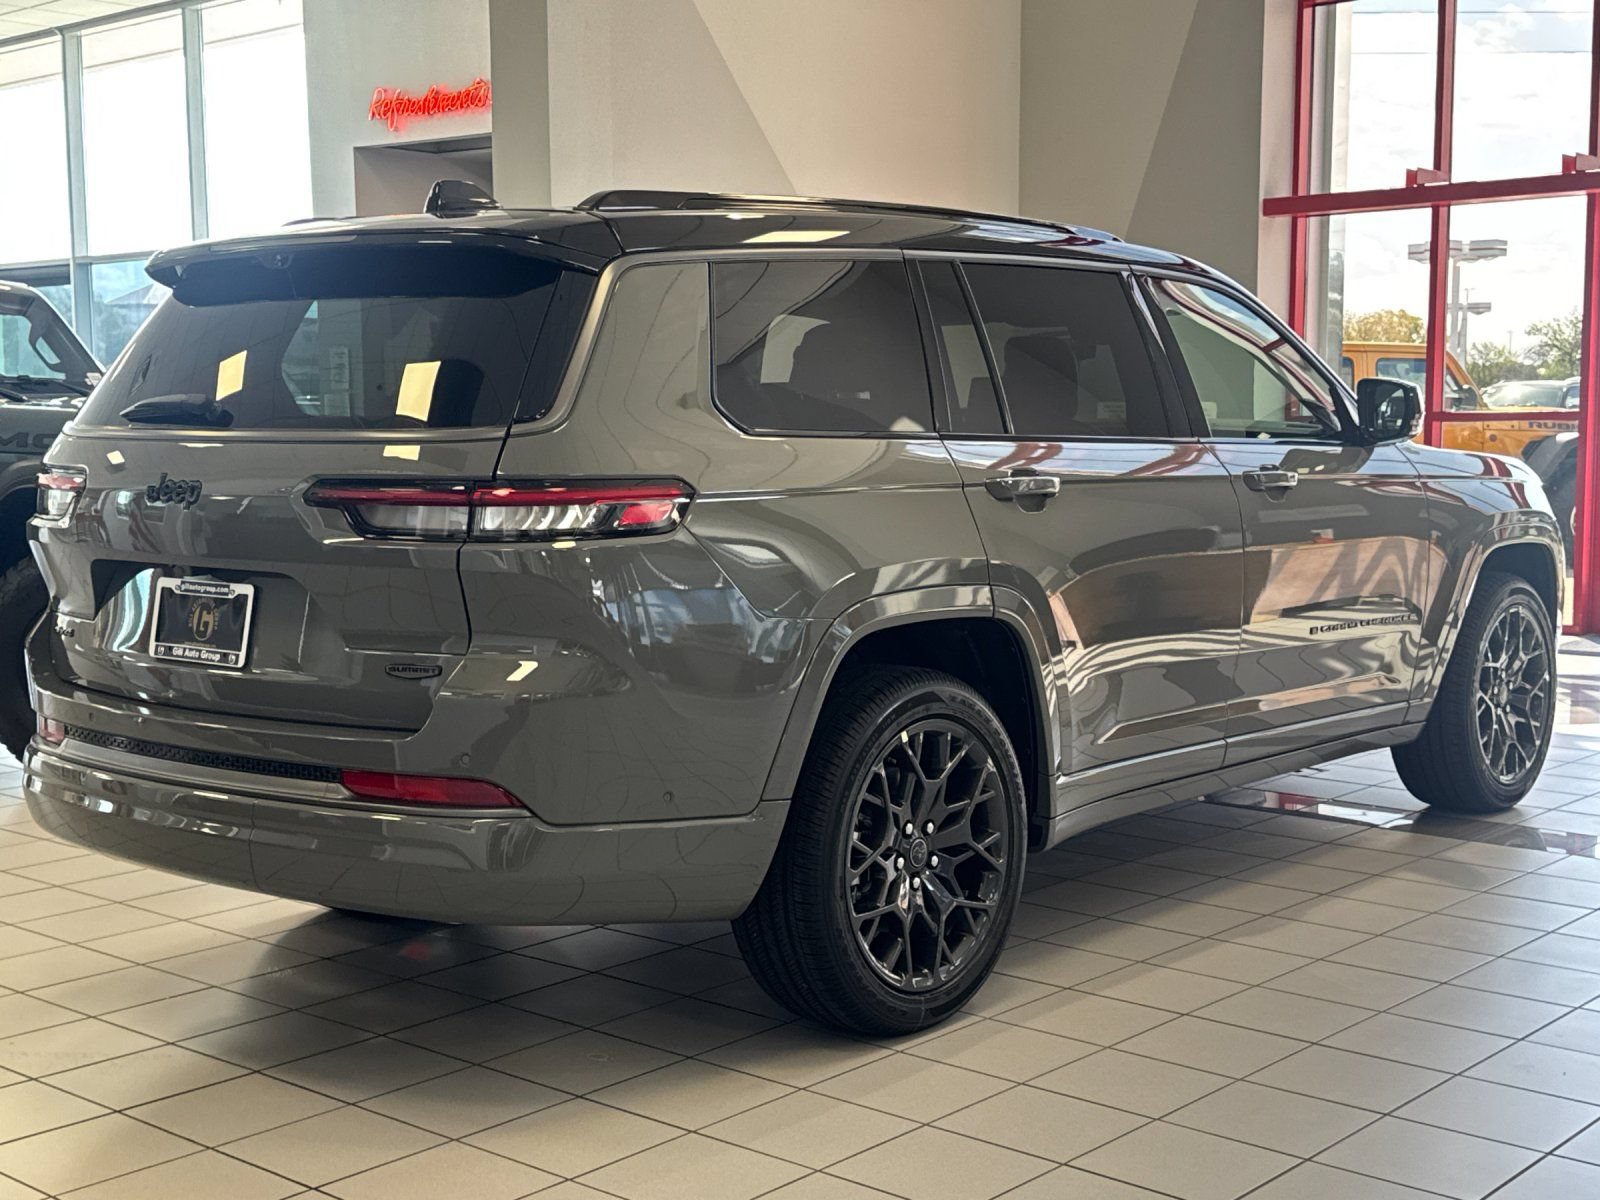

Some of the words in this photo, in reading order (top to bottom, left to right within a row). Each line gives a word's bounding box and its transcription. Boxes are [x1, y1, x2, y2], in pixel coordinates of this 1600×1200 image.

[145, 472, 202, 510] Jeep
[181, 583, 229, 593] gillautogroup.com
[172, 647, 184, 656] Gill
[184, 648, 199, 658] Auto
[200, 650, 221, 662] Group
